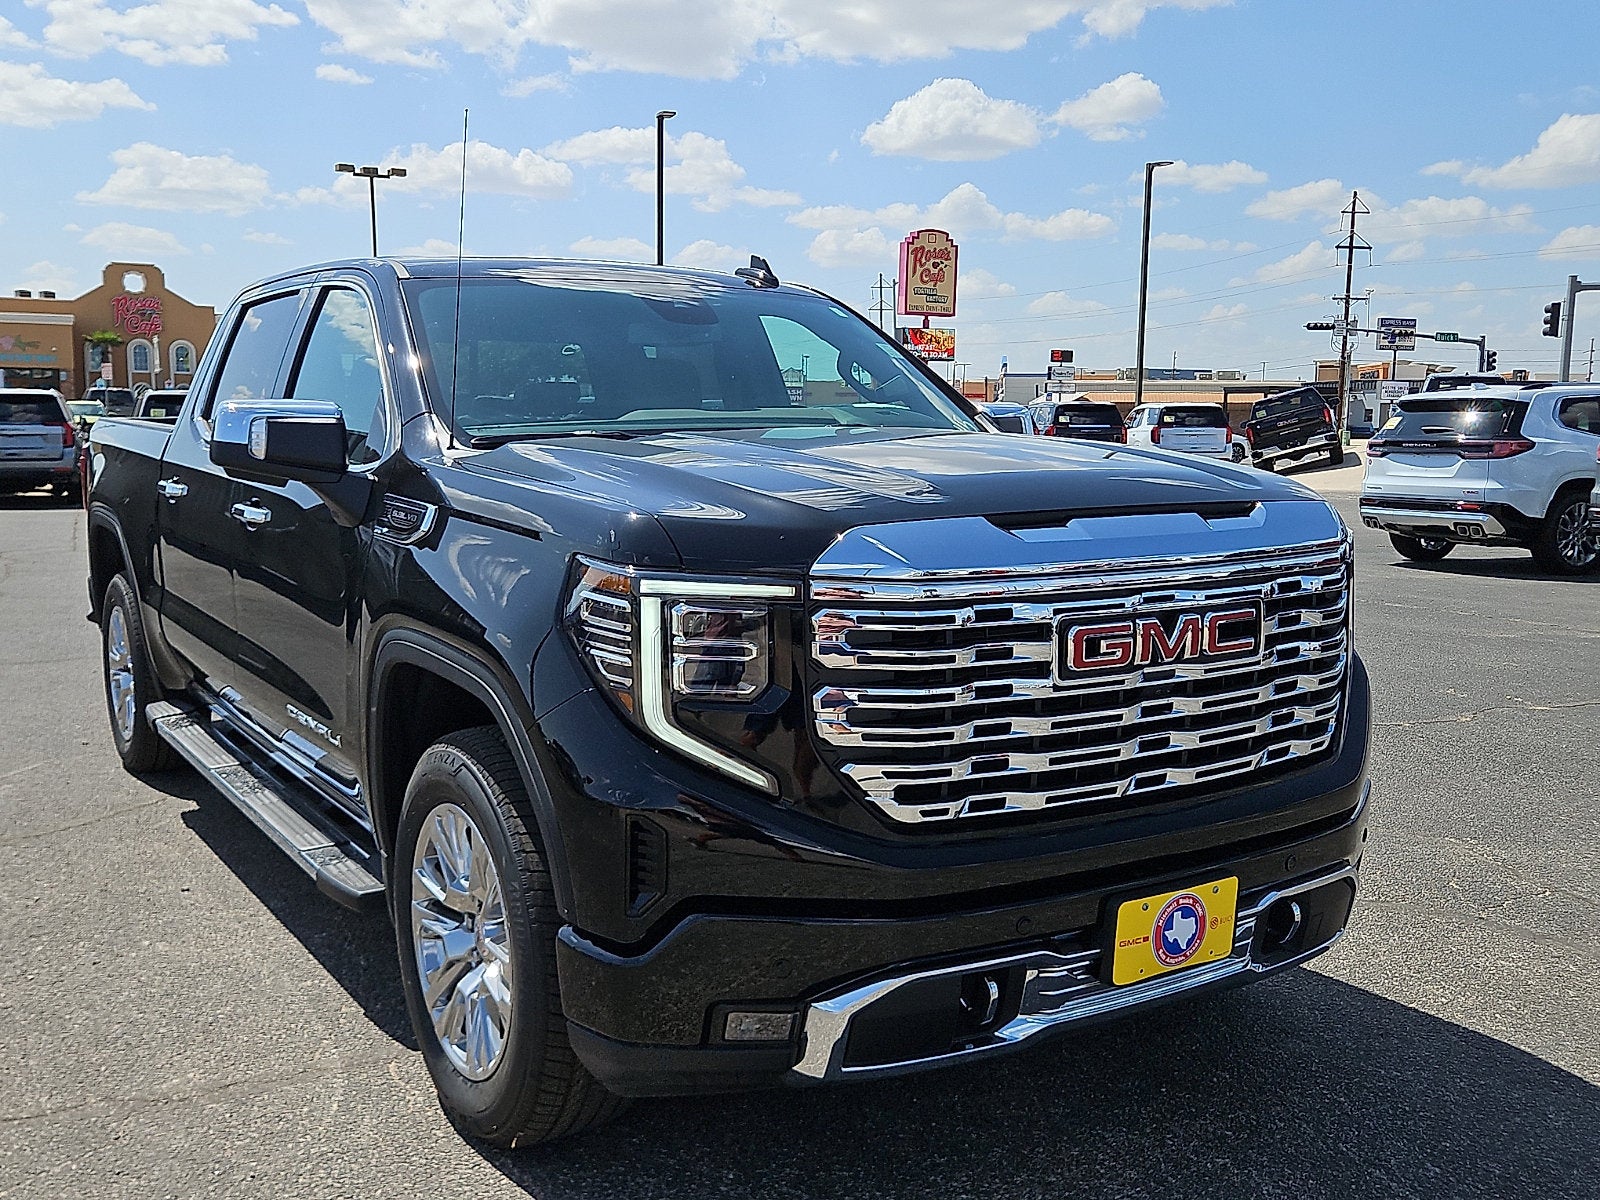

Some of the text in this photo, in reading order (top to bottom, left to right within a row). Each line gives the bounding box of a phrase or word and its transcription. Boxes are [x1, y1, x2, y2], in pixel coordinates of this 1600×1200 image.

[910, 245, 952, 278] Rosa's
[914, 287, 937, 295] TORTILLA
[111, 295, 163, 327] Rosa's
[1436, 333, 1454, 341] Buick
[1067, 608, 1256, 671] GMC
[285, 703, 342, 748] DENALI
[1157, 900, 1178, 927] Mitchell
[1119, 938, 1142, 948] GMC
